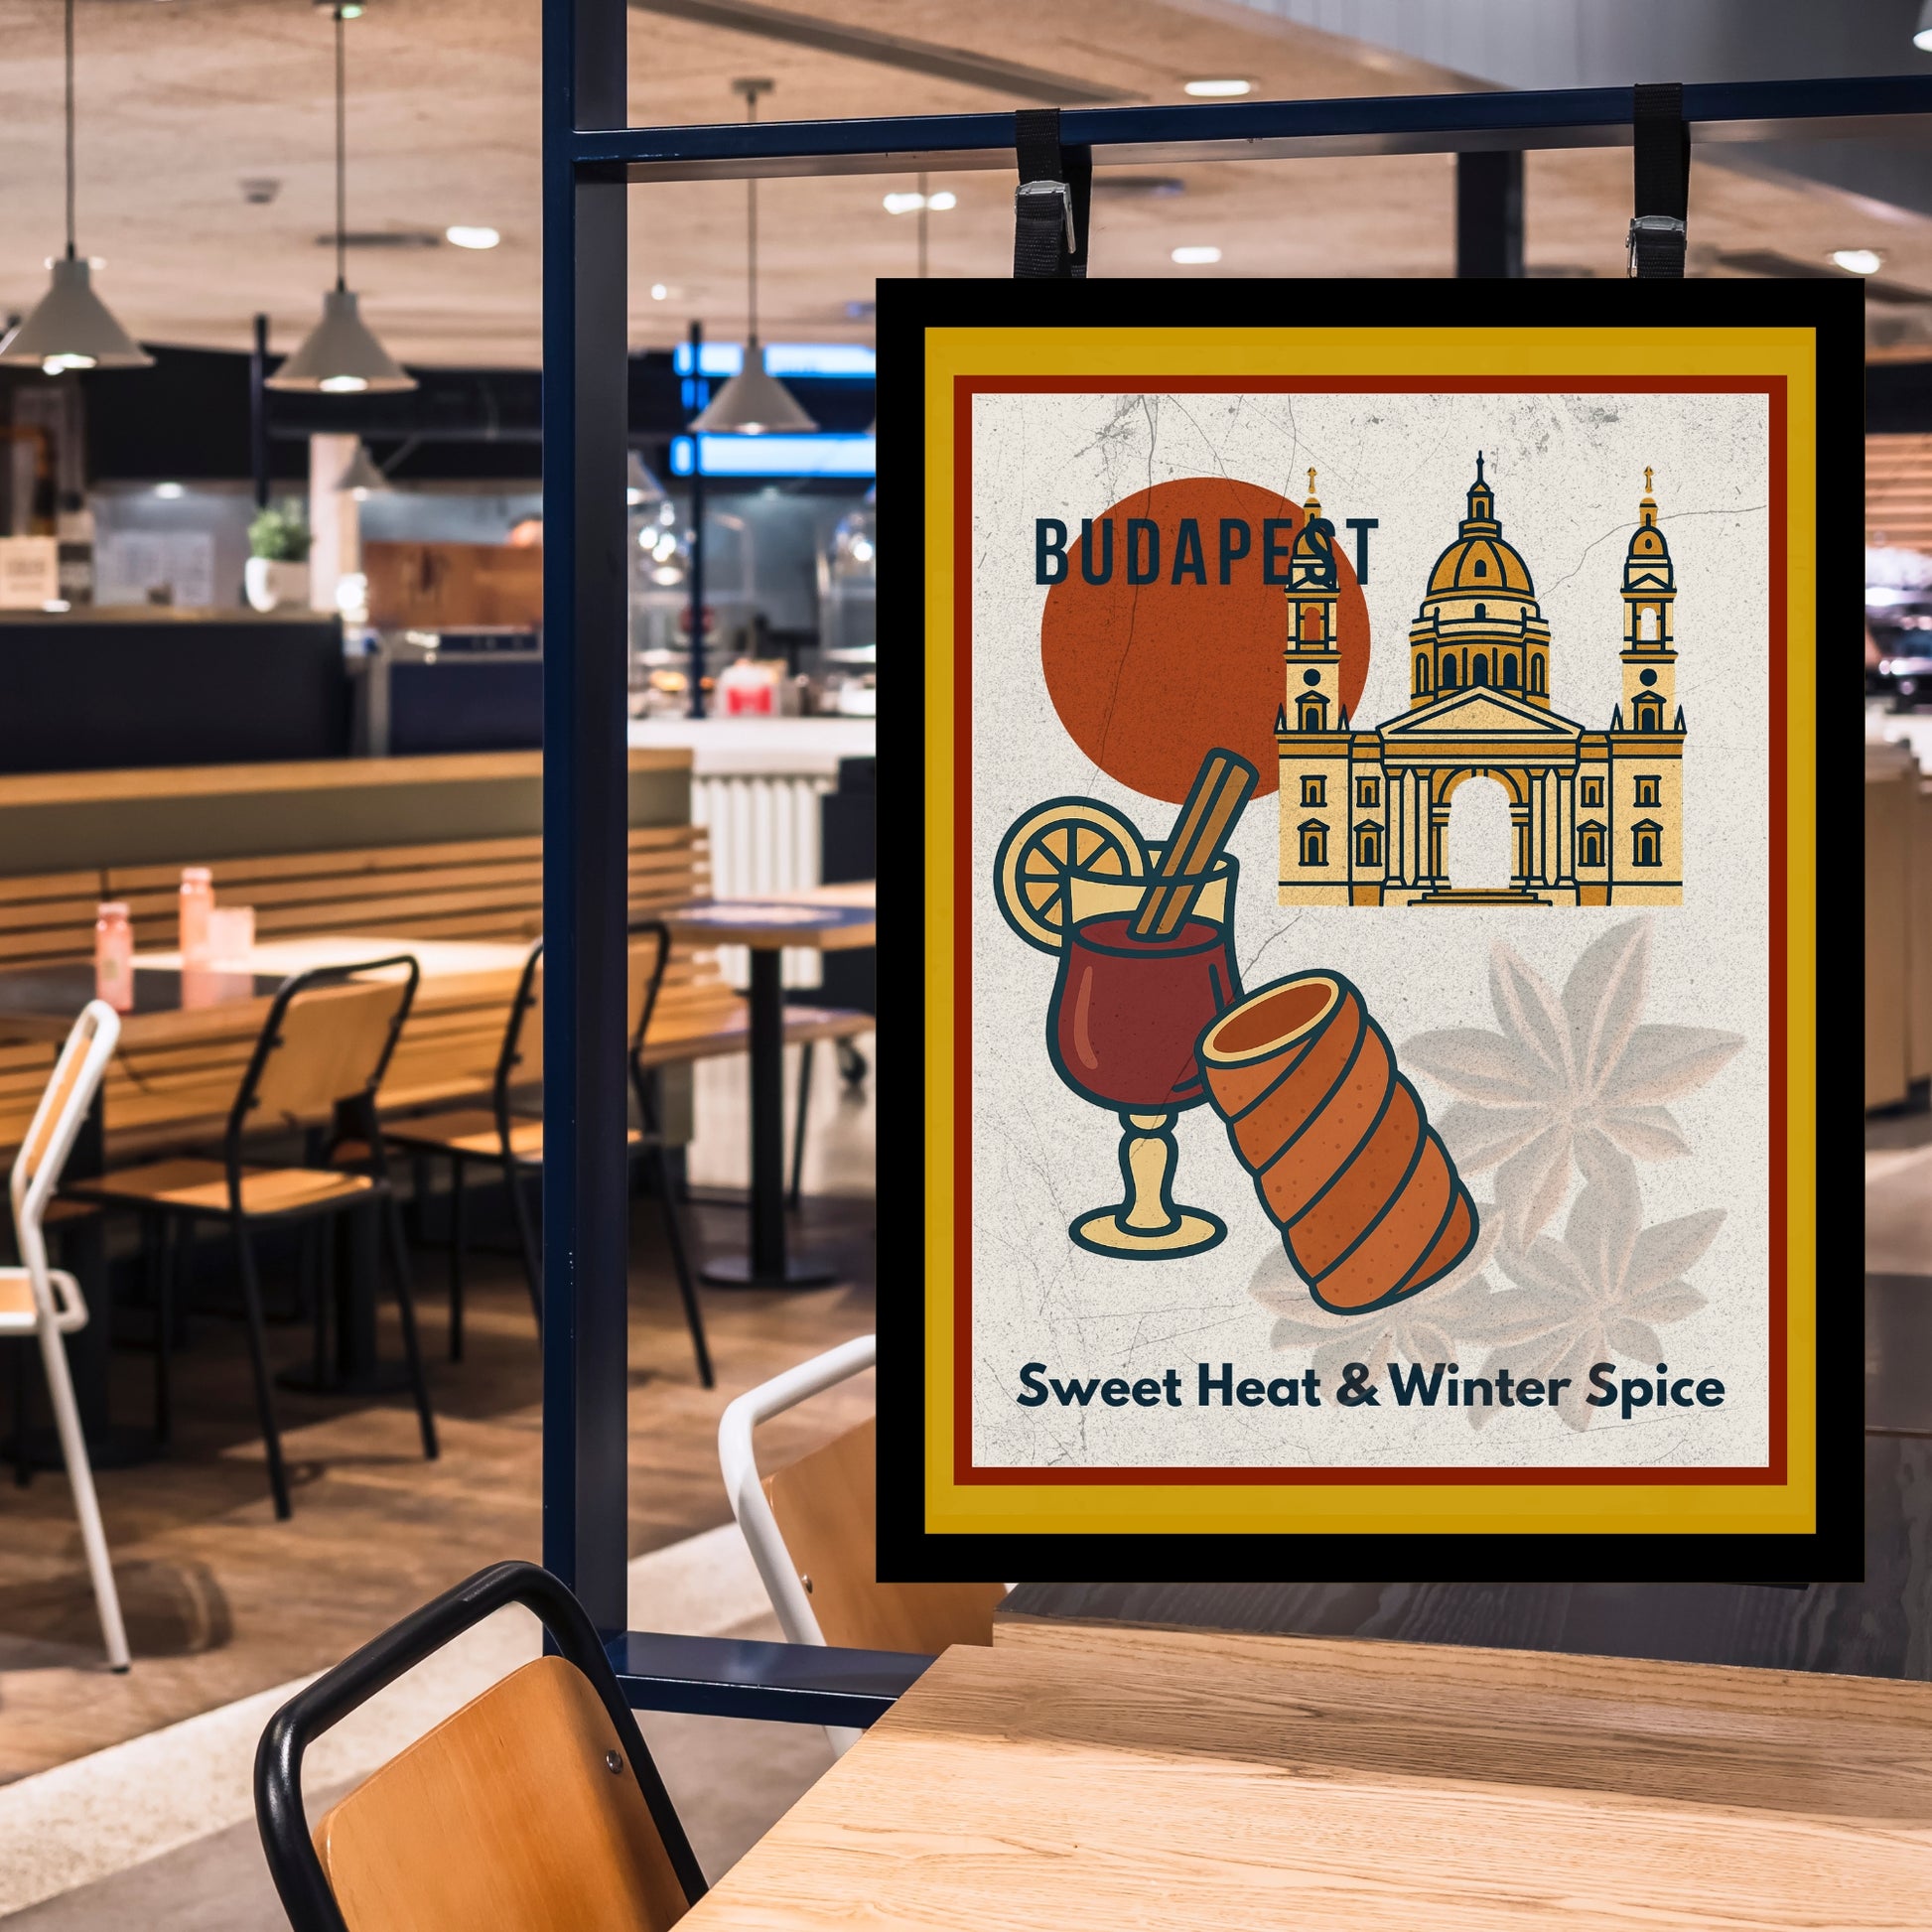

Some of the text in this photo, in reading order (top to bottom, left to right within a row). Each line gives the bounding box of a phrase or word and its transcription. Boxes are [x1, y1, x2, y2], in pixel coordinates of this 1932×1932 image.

[1035, 517, 1379, 586] BUDAPEST
[1017, 1362, 1725, 1420] Sweet Heat & Winter Spice
